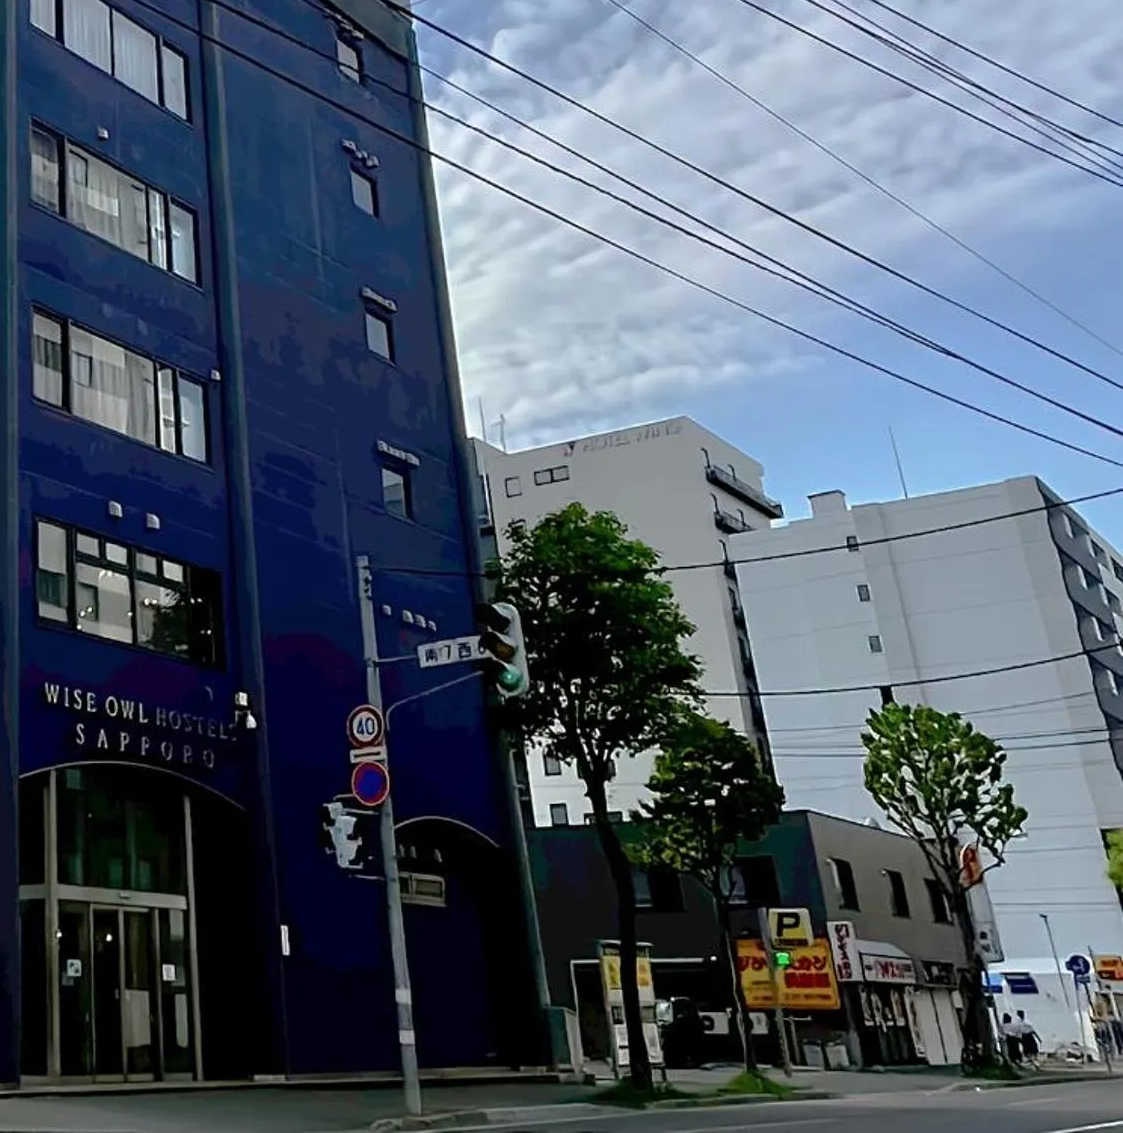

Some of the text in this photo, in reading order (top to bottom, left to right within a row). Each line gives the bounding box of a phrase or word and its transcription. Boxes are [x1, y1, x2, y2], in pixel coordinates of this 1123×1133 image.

[44, 682, 97, 712] WISE
[105, 696, 148, 723] OWL
[356, 717, 375, 735] 40
[76, 723, 215, 768] SAPPORO
[776, 912, 800, 937] P
